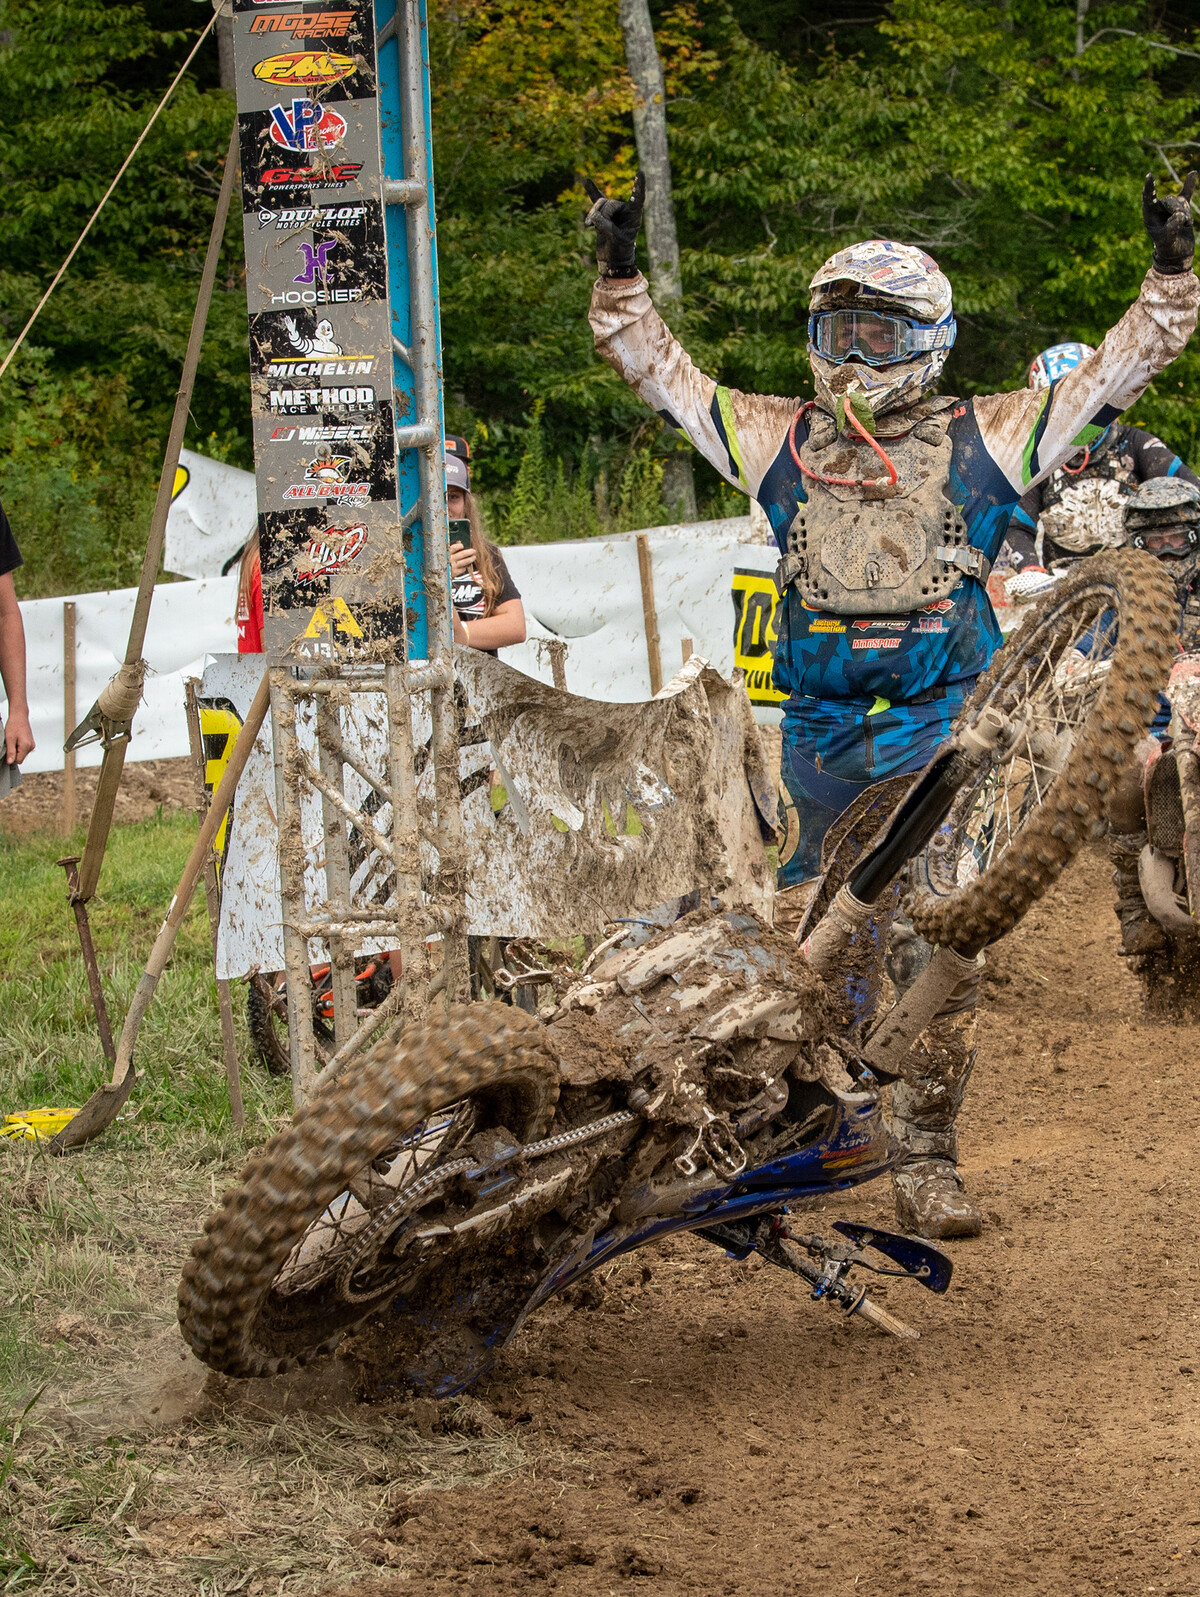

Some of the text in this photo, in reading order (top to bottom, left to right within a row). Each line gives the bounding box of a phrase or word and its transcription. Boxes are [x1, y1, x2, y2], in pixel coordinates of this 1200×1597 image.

[250, 10, 357, 32] MOOSE
[291, 27, 347, 39] RACING
[255, 55, 357, 79] FMF
[269, 98, 324, 150] VP
[269, 183, 320, 191] POWERSPORTS
[279, 207, 367, 221] DUNLOP
[275, 218, 360, 229] MOTORYCLE TIRES
[271, 289, 362, 304] HOOSIER
[267, 361, 373, 377] MICHELIN
[269, 387, 374, 406] METHOD
[315, 403, 374, 413] WHEELS
[284, 482, 370, 498] ALL BALLS
[918, 617, 943, 630] TM
